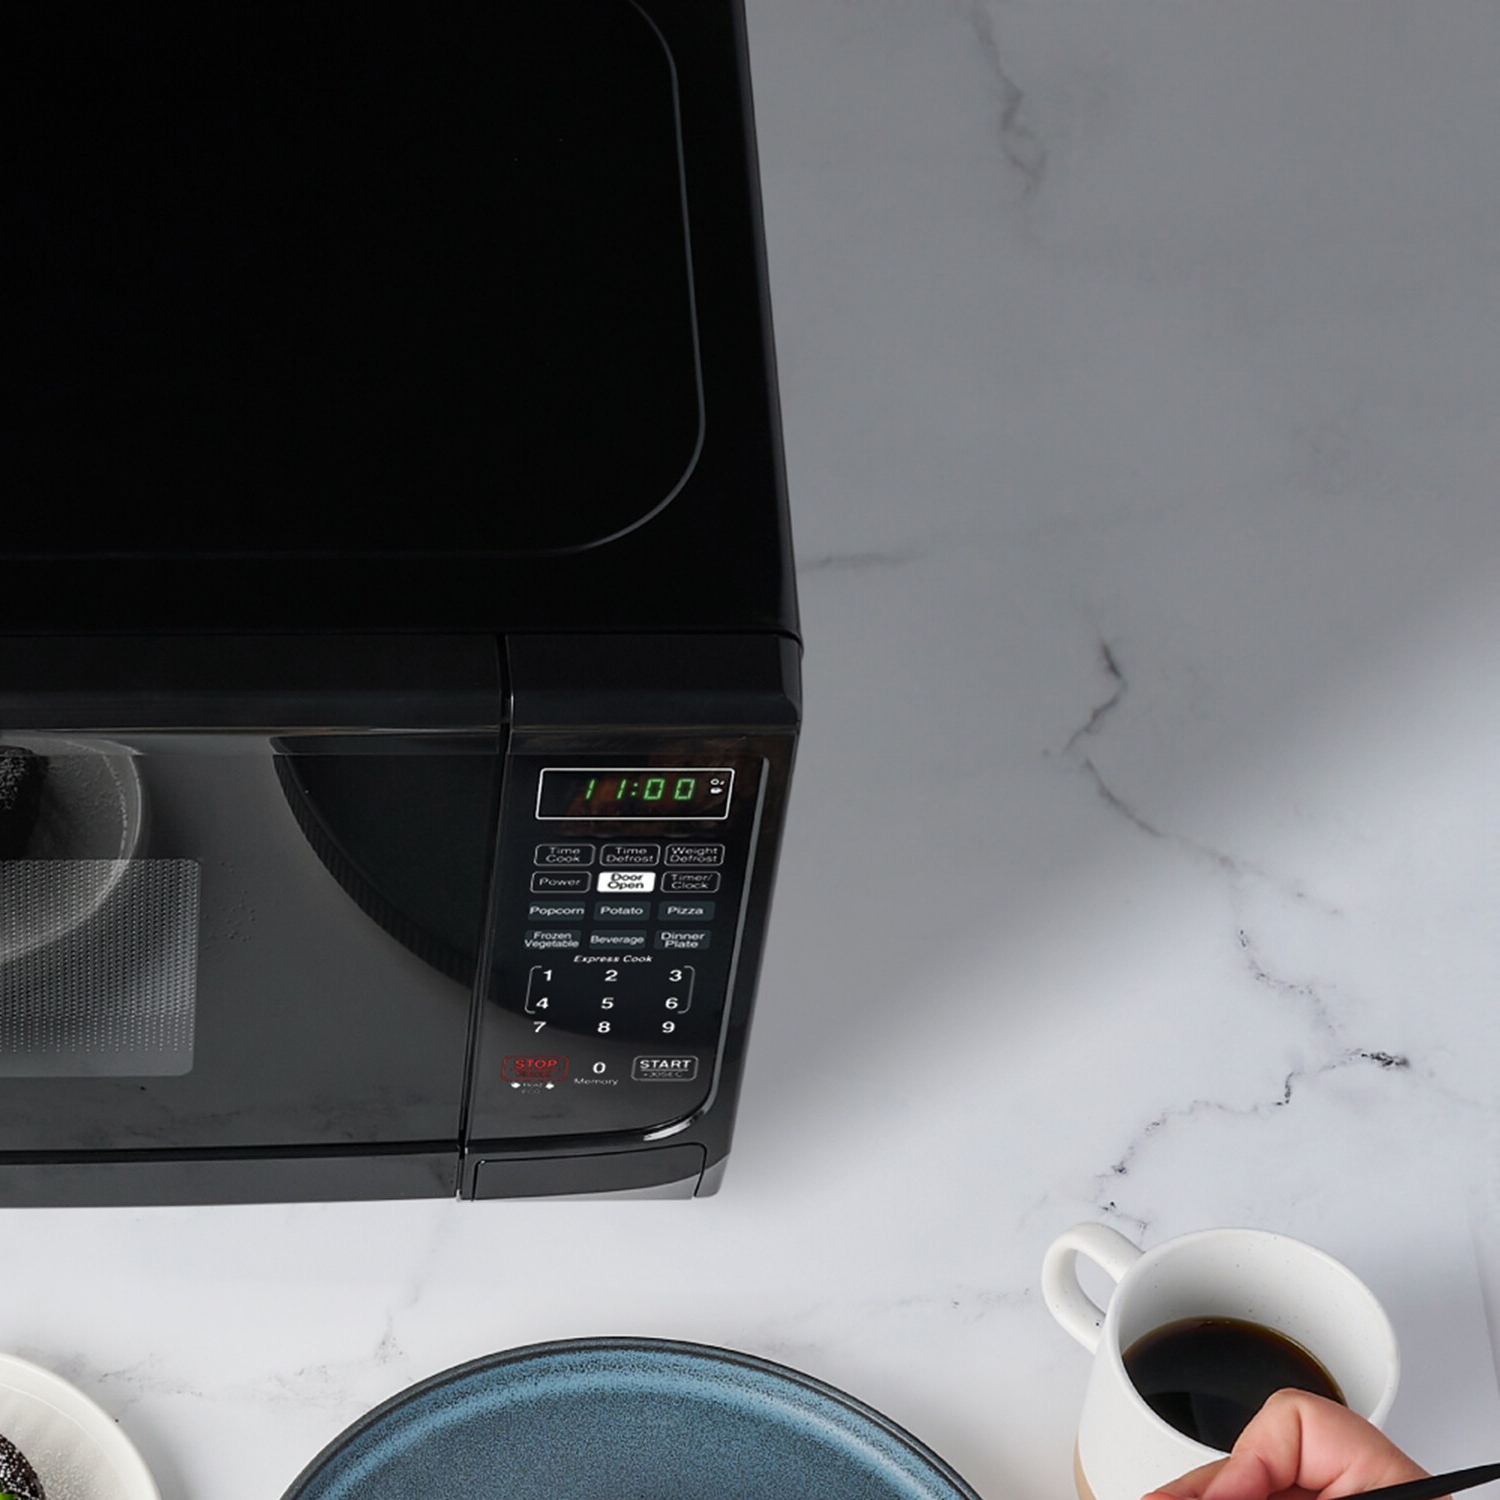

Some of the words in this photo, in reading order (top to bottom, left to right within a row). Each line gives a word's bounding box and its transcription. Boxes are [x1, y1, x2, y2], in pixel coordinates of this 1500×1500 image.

[586, 778, 696, 800] 11:00
[671, 847, 718, 855] Weight
[539, 878, 580, 886] Power
[608, 882, 644, 890] Open
[529, 907, 584, 916] Popcorn
[601, 907, 643, 915] Potato
[667, 907, 703, 915] Pizza
[534, 932, 571, 940] Frozen
[591, 936, 644, 945] Beverage
[661, 932, 705, 941] Dinner
[525, 940, 579, 948] Vegetable
[573, 955, 619, 963] Express
[544, 970, 552, 981] 1
[604, 970, 618, 982] 2
[669, 970, 682, 982] 3
[536, 998, 548, 1009] 4
[601, 998, 614, 1009] 5
[665, 998, 678, 1009] 6
[534, 1022, 546, 1032] 7
[597, 1021, 610, 1033] 8
[662, 1021, 675, 1033] 9
[515, 1060, 558, 1069] STOP
[593, 1062, 606, 1074] 0
[640, 1059, 691, 1069] START
[574, 1078, 619, 1086] Memory
